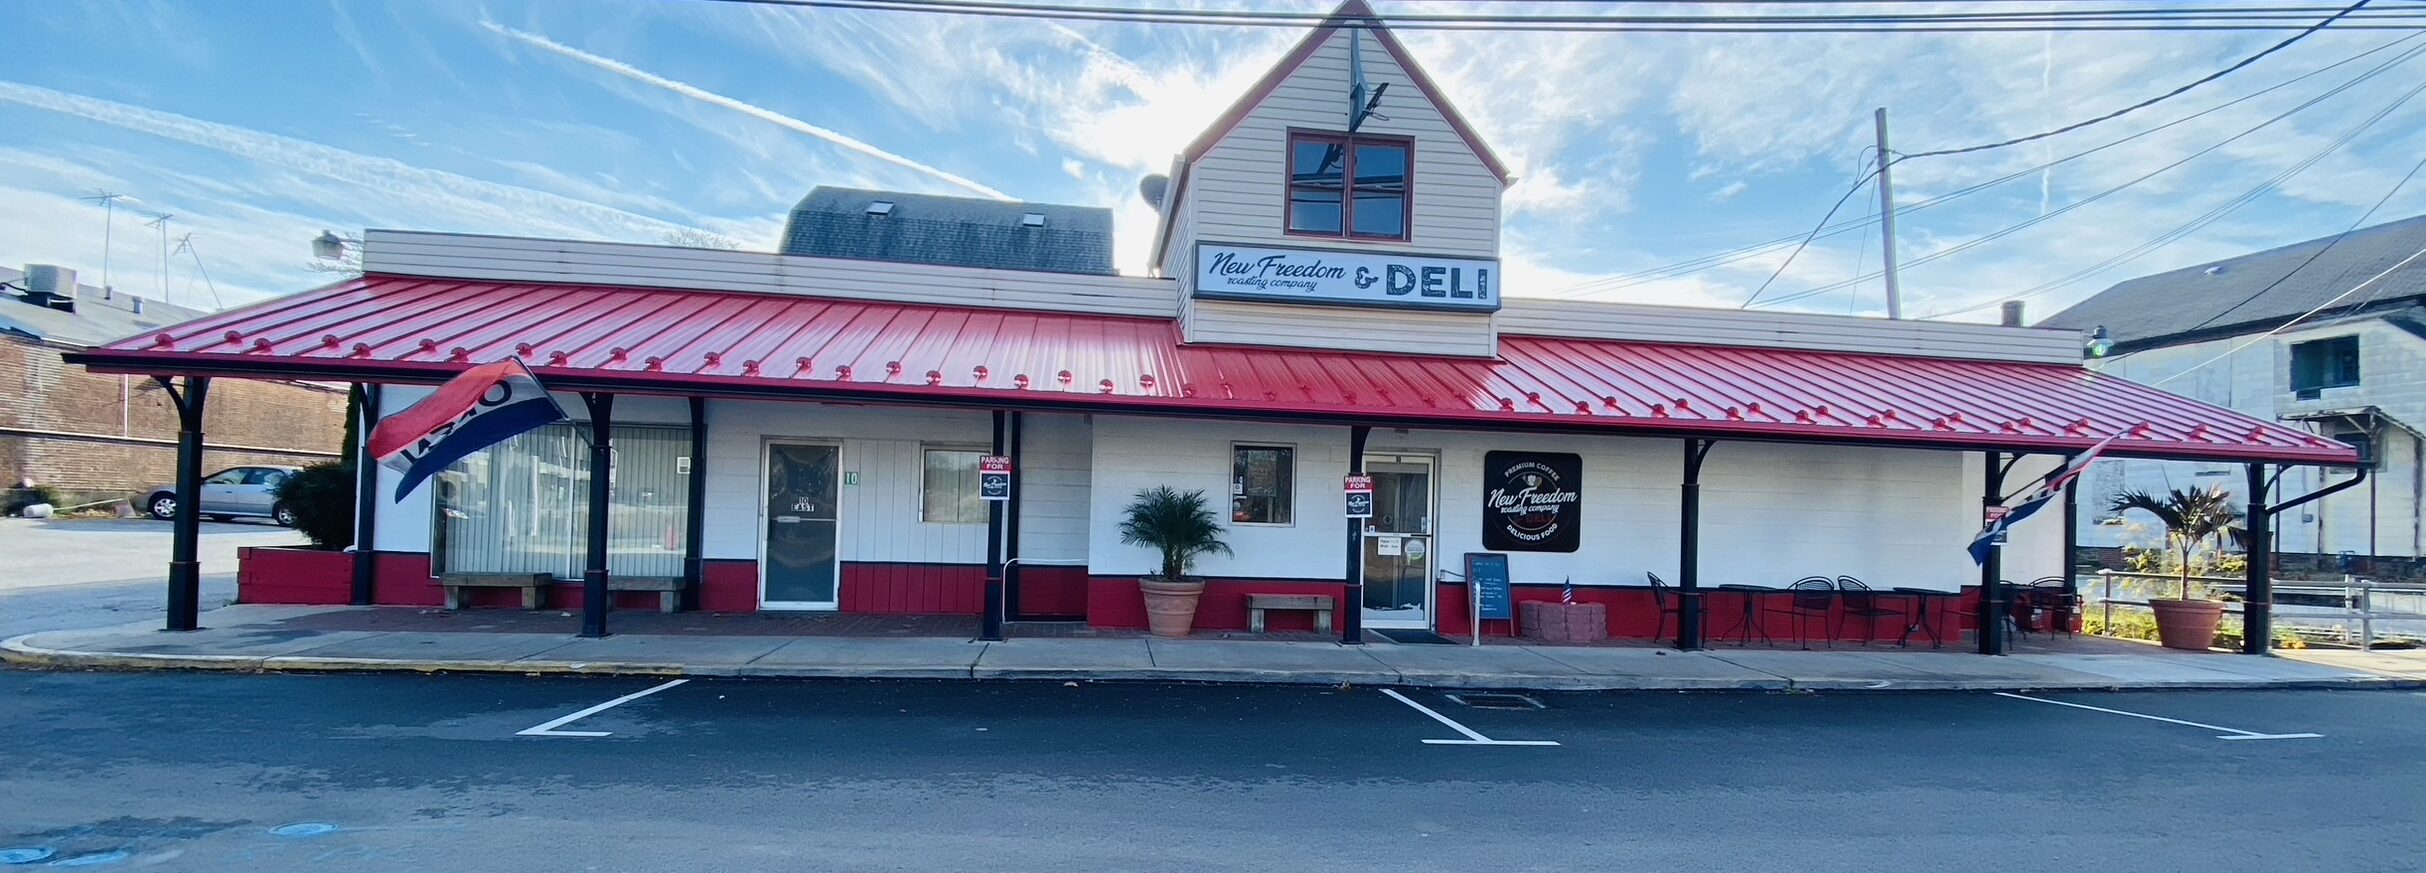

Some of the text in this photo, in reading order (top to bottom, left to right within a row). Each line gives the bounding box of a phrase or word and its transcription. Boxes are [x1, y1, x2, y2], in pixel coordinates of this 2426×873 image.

[1209, 252, 1346, 279] New Freedom
[1227, 275, 1317, 292] roasting company
[1354, 264, 1488, 299] & DELI
[981, 456, 1009, 465] PARKING
[846, 472, 858, 484] 10
[1345, 476, 1371, 484] PARKING
[1504, 462, 1560, 481] PREMIUM COFFEE
[1488, 486, 1578, 508] New Freedom
[791, 503, 815, 512] EAST
[1500, 504, 1560, 516] roasting company
[1507, 523, 1558, 541] DELICIOUS FOOD
